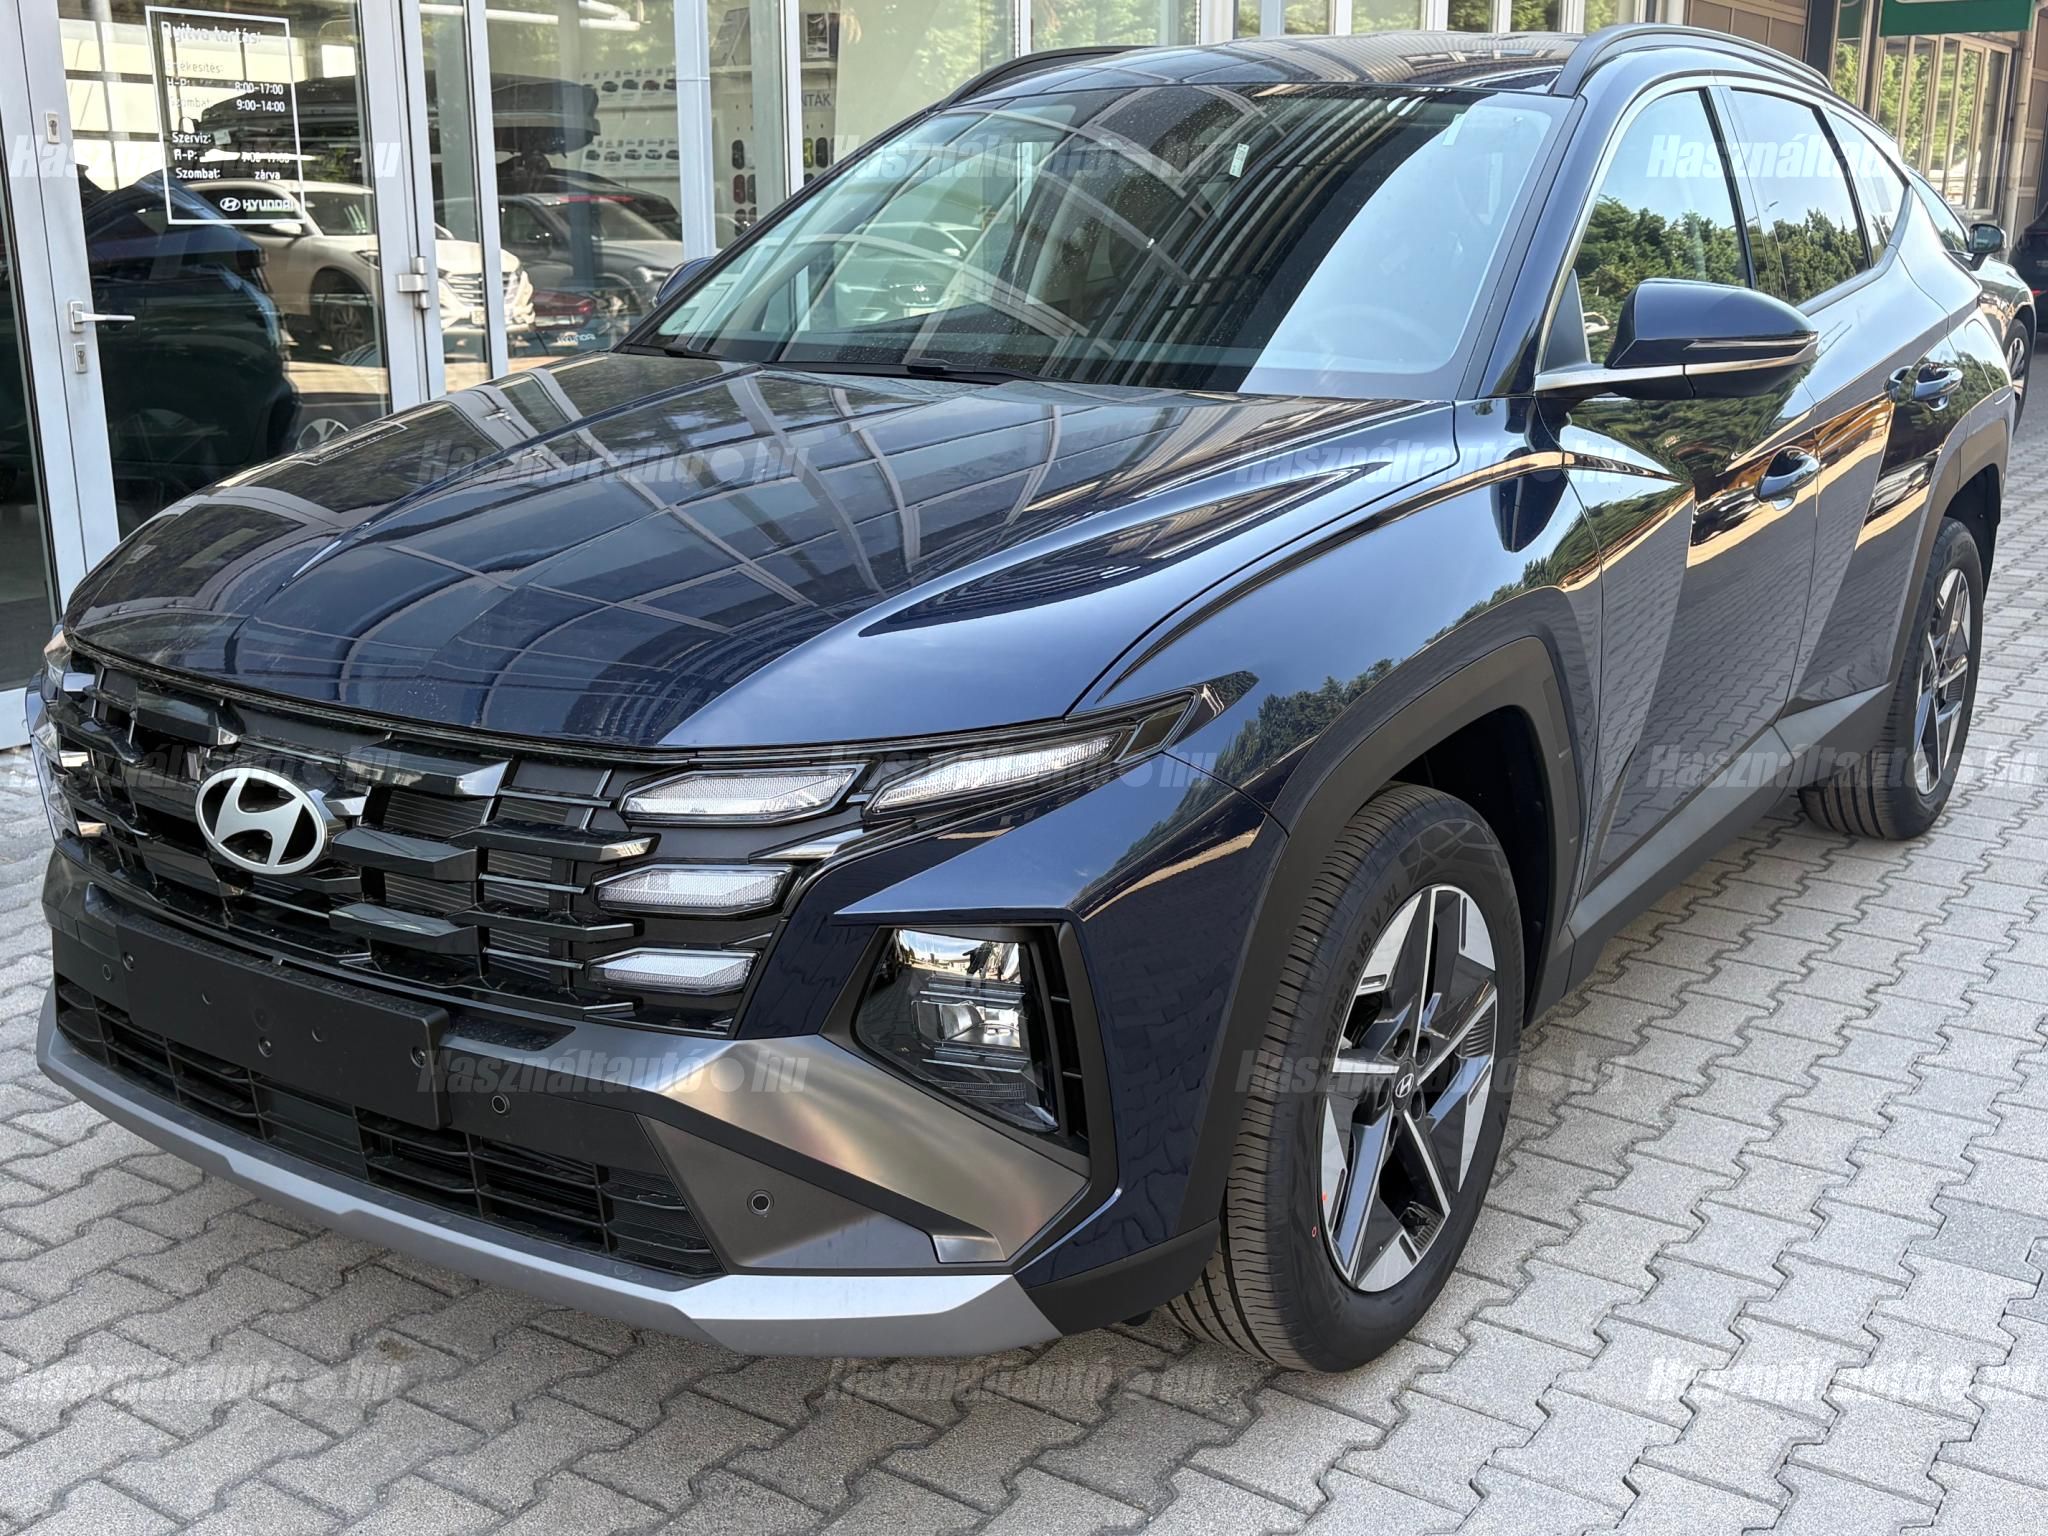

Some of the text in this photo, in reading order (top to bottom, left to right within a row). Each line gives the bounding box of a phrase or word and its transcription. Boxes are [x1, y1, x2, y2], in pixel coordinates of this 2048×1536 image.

[234, 81, 284, 95] 8:00-17:00
[236, 99, 286, 112] 9:00-14:00
[171, 131, 212, 144] Szerviz:
[175, 167, 281, 180] Szombat: zárva
